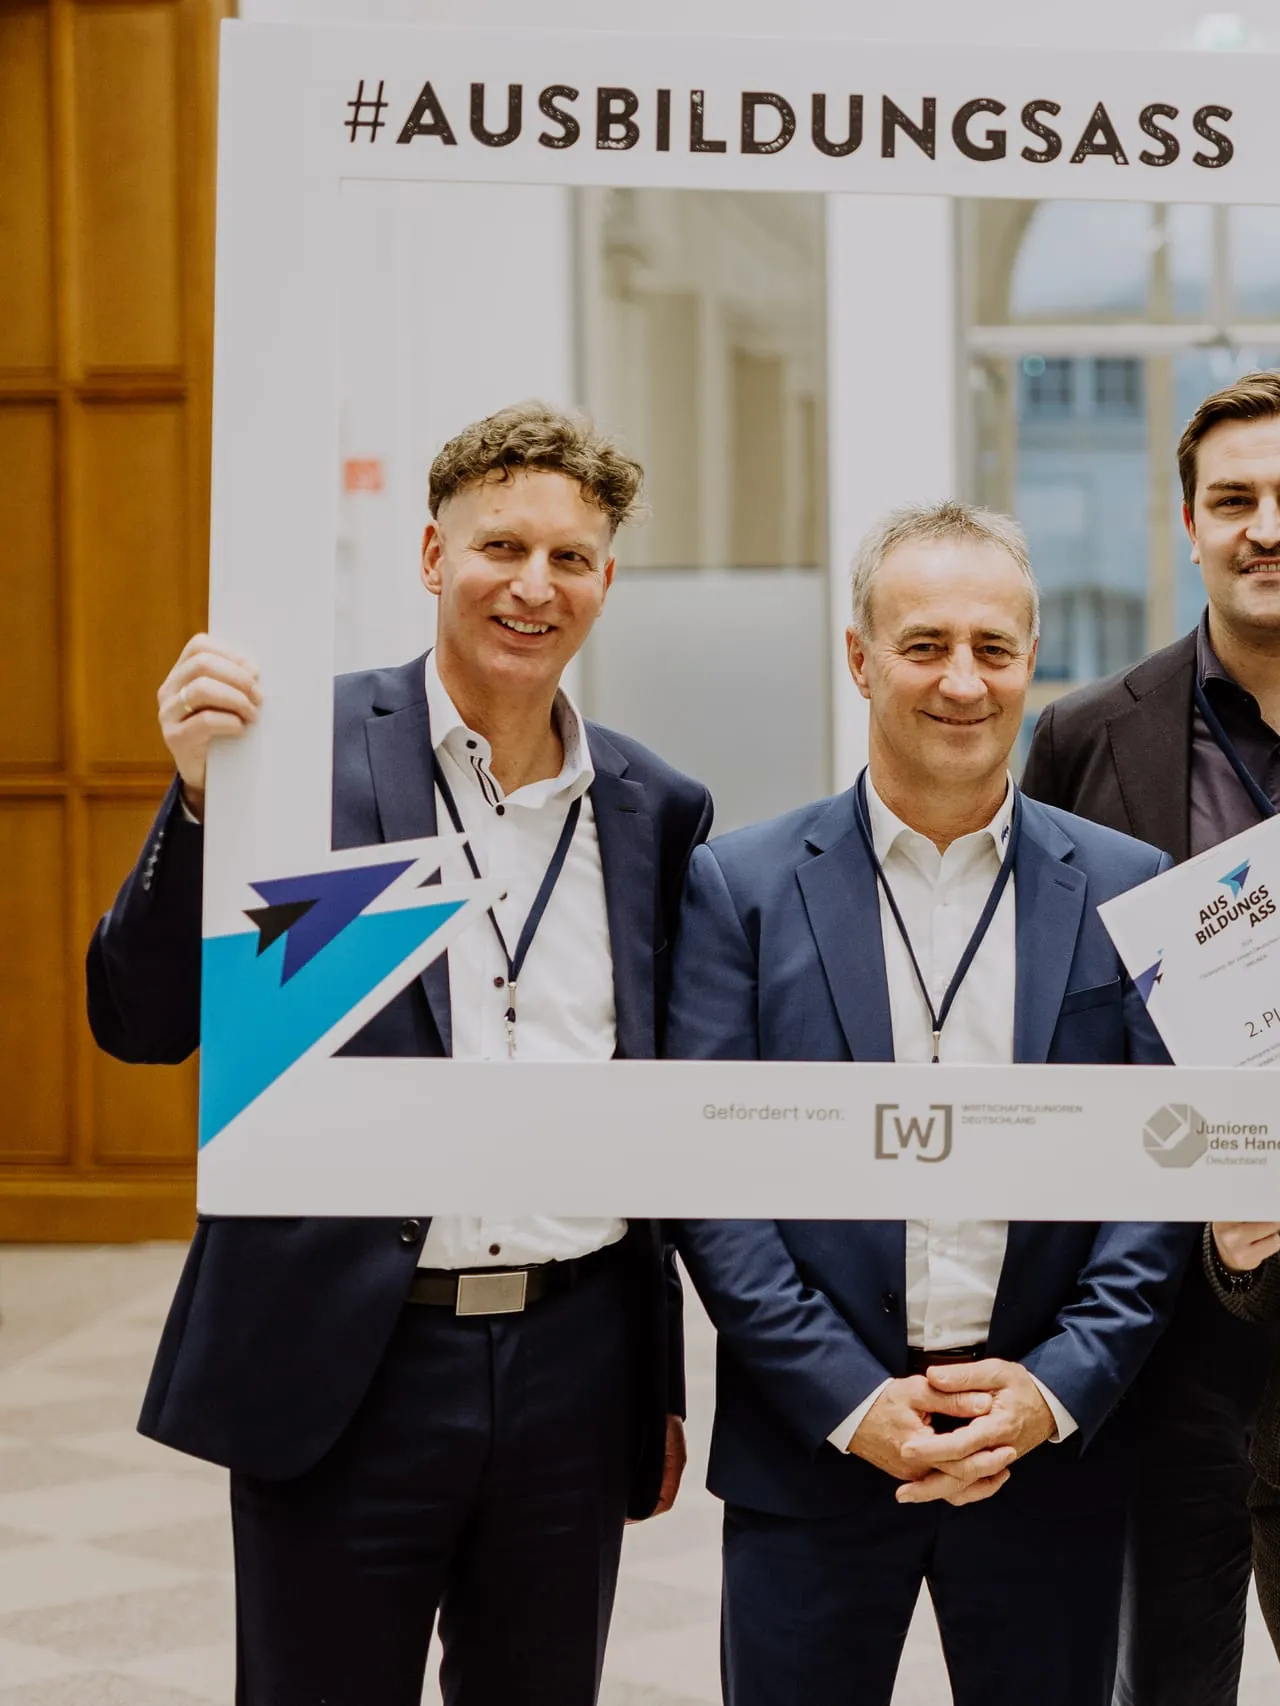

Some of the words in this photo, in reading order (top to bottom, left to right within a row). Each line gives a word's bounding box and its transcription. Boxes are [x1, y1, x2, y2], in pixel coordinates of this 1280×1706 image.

[343, 79, 1235, 169] #AUSBILDUNGSASS
[1195, 884, 1269, 945] BILDUNGS
[1199, 894, 1228, 925] AUS
[1249, 899, 1276, 928] ASS
[1244, 1021, 1263, 1038] 2.
[702, 1103, 800, 1122] Gefördert
[805, 1106, 845, 1121] von:
[1196, 1116, 1268, 1135] Junioren
[1210, 1137, 1239, 1151] des
